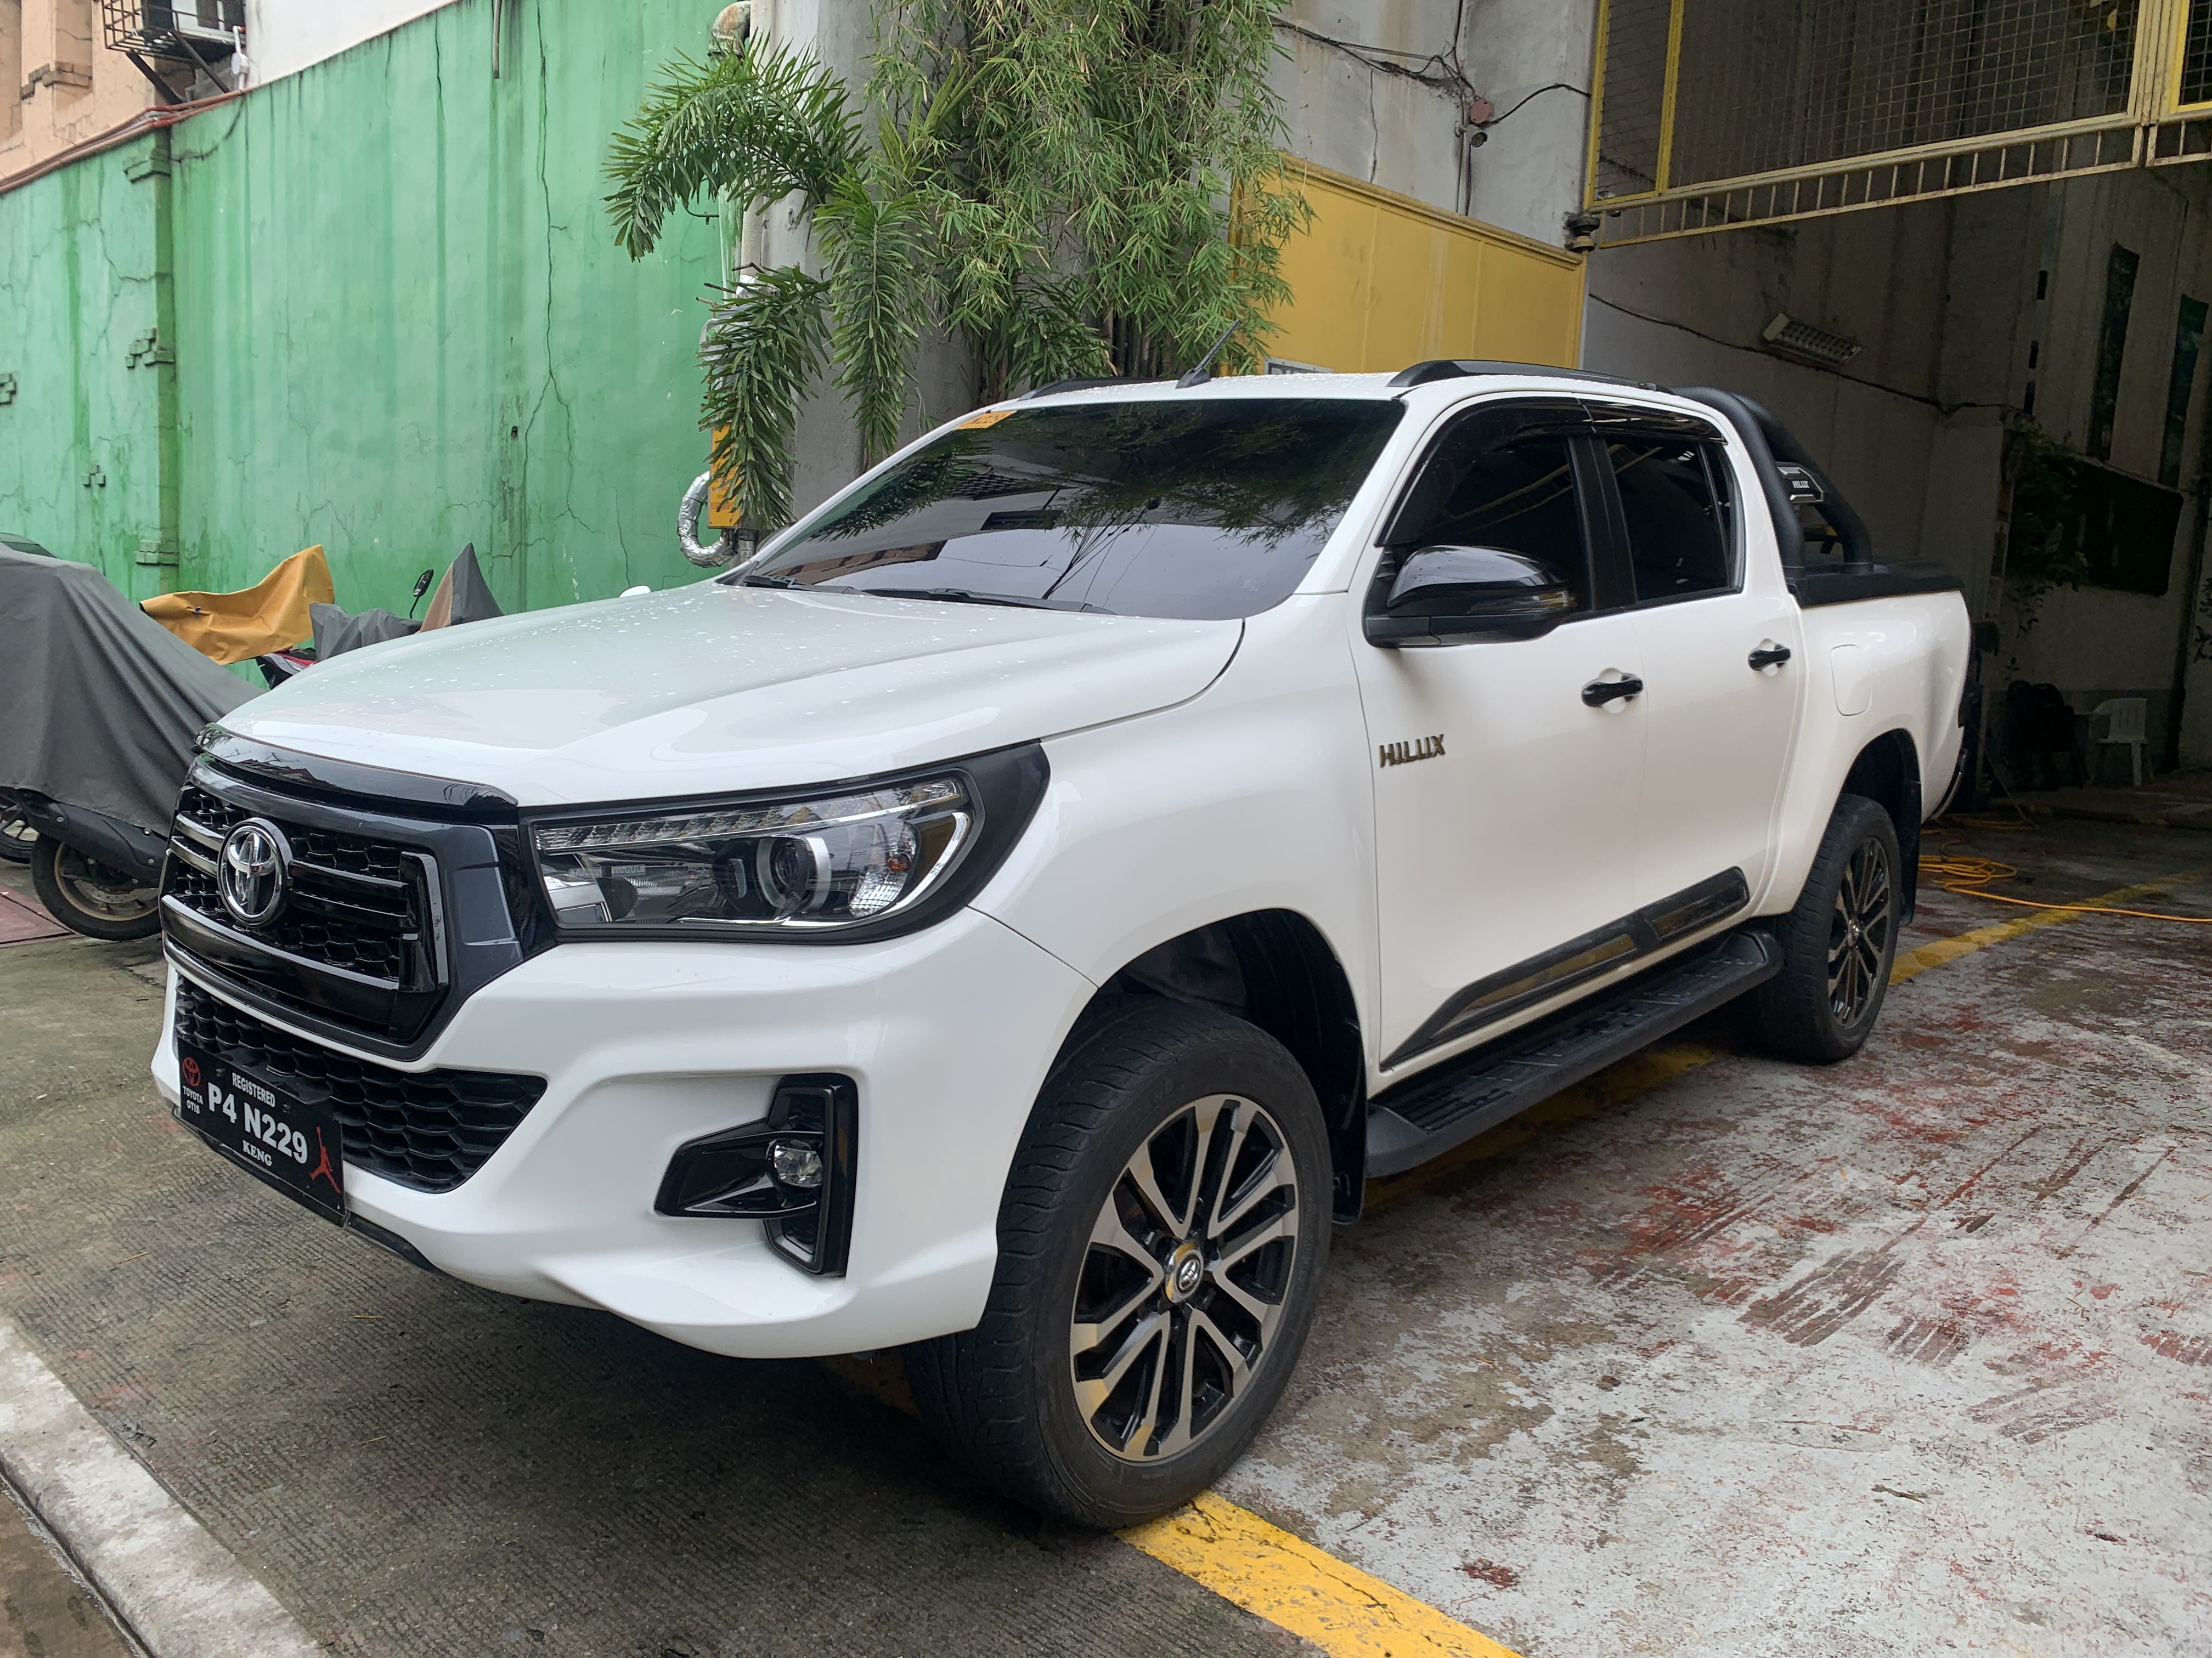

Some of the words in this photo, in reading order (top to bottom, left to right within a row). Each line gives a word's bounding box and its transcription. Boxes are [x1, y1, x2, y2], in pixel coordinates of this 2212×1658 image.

[1379, 734, 1446, 768] HILUX
[183, 1085, 204, 1105] TOYOTA
[232, 1072, 275, 1107] REGISTERED
[187, 1100, 200, 1114] OTIS
[208, 1082, 237, 1124] P4
[244, 1102, 308, 1164] N229
[242, 1140, 273, 1167] KENG
